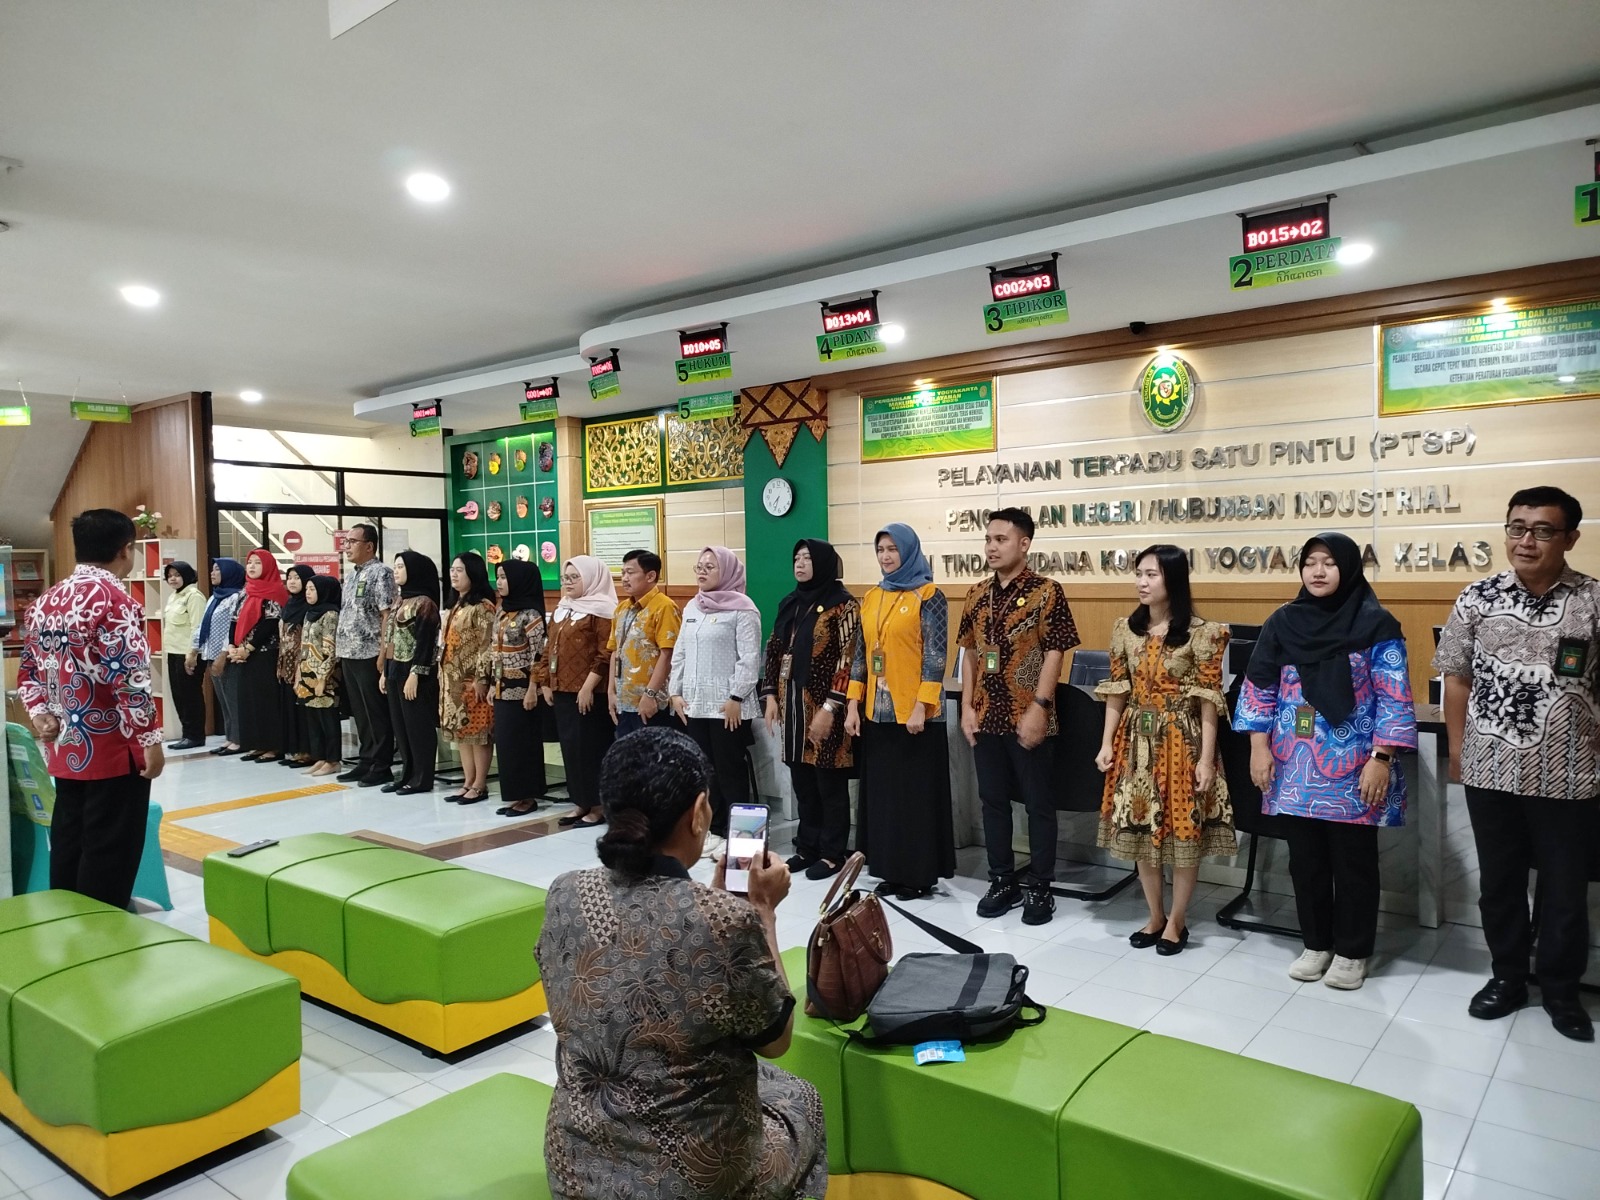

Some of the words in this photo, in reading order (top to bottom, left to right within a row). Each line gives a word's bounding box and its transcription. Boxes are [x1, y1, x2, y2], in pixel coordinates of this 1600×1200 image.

[1581, 187, 1600, 222] 1
[1247, 226, 1289, 247] B015
[1300, 220, 1322, 237] 02
[1255, 243, 1337, 271] PERDATA
[1232, 259, 1253, 288] 2
[994, 280, 1027, 296] C002
[1034, 275, 1051, 288] 03
[1003, 294, 1064, 316] TIPIKOR
[857, 310, 871, 322] 04
[987, 306, 1003, 331] 3
[1517, 315, 1568, 328] YOGYAKARTA
[1559, 321, 1592, 331] PUBLIK
[820, 337, 833, 359] 4
[678, 363, 688, 382] 5
[689, 356, 727, 370] HUKUM
[591, 383, 597, 399] 6
[521, 406, 527, 420] 7
[680, 401, 690, 419] 5
[411, 423, 417, 436] 8
[937, 458, 1060, 487] PELAYANAN
[1069, 449, 1184, 478] TERPADU
[1191, 442, 1262, 470] SATU
[1269, 435, 1356, 466] PINTU
[1369, 423, 1477, 462] (PTSP)
[1072, 500, 1142, 524] NEGERI
[1294, 484, 1461, 516] INDUSTRIAL
[1027, 550, 1094, 574] IDANA
[1394, 540, 1492, 569] KELAS
